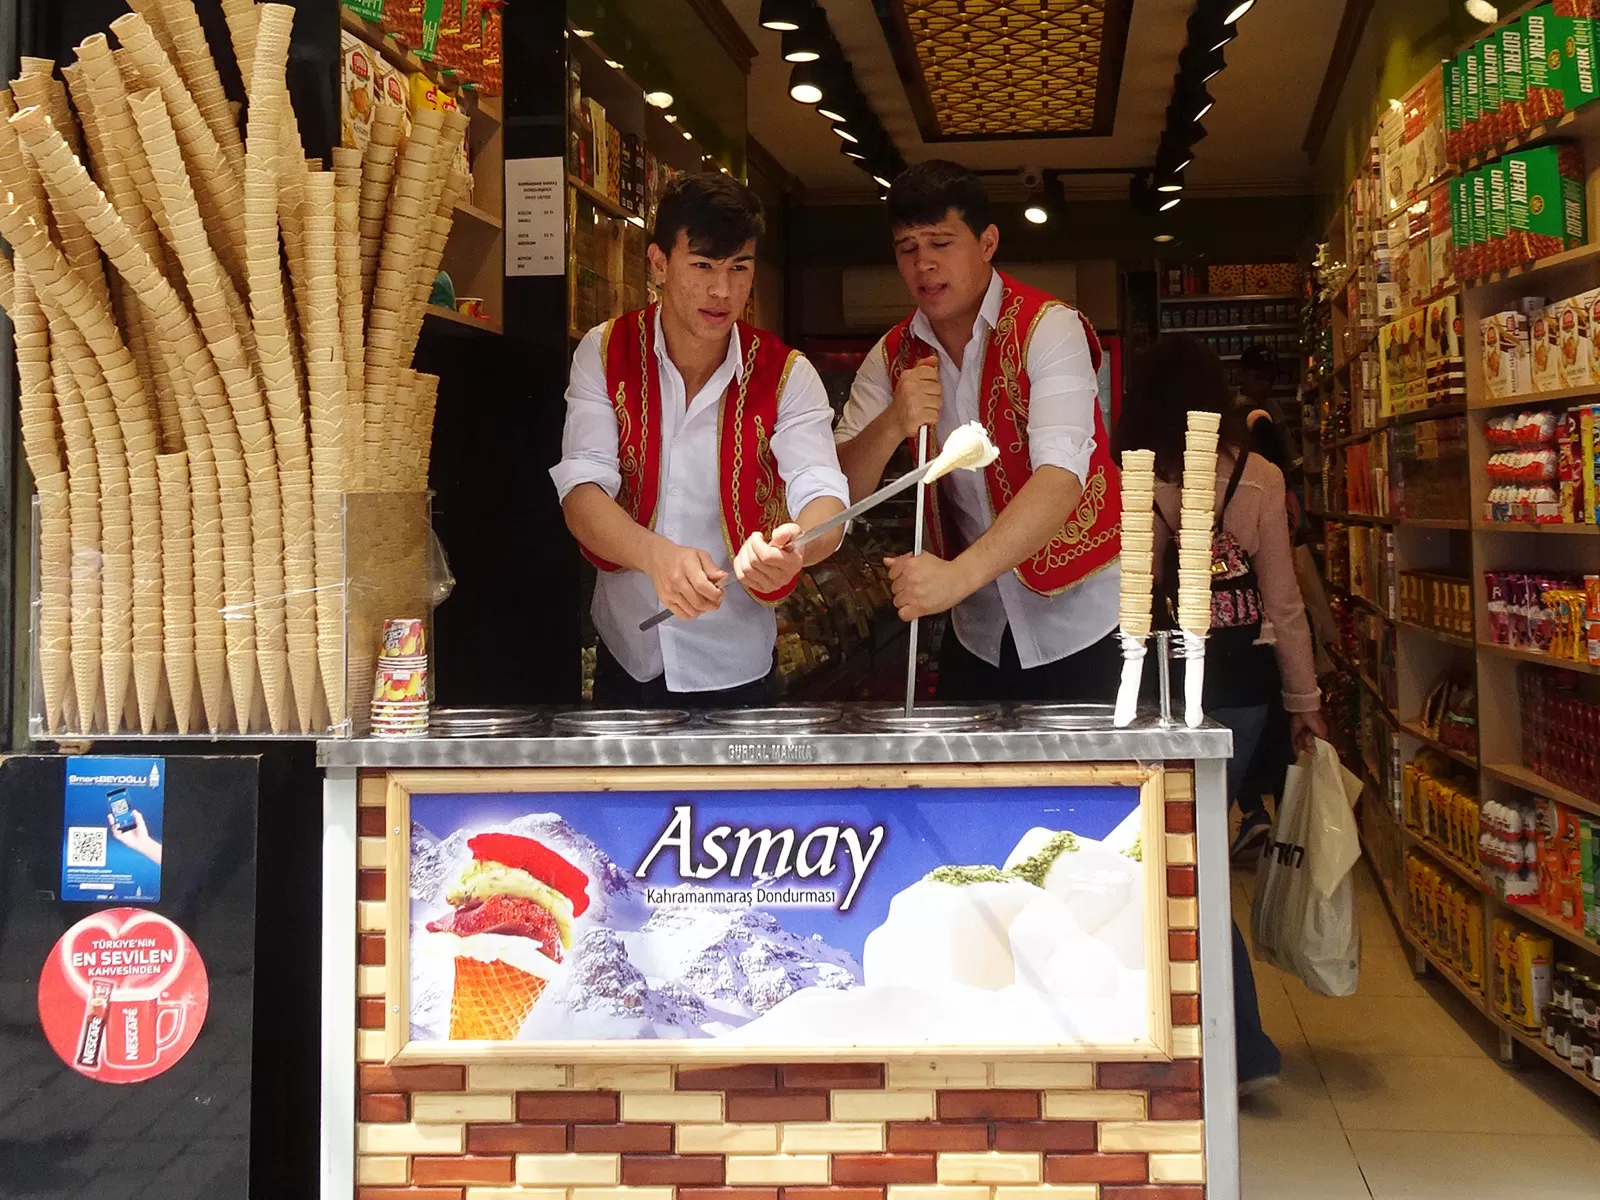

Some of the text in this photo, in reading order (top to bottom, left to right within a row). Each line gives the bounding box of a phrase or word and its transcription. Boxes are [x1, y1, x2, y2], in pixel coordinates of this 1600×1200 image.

[1502, 31, 1522, 74] GOFRIK
[1528, 16, 1546, 59] GOFRIK
[1576, 47, 1593, 93] GOFRIK
[1509, 160, 1528, 204] GOFRIK
[1565, 199, 1582, 238] GOFRIK
[634, 805, 885, 911] Asmay
[647, 888, 836, 907] Kahramanmaraş Dondurması
[73, 949, 173, 967] EN SEVİLEN
[91, 938, 156, 949] TÜRKİYE'NİN
[88, 965, 161, 976] KAHVESİNDEN
[122, 1007, 139, 1061] NESCAFÉ
